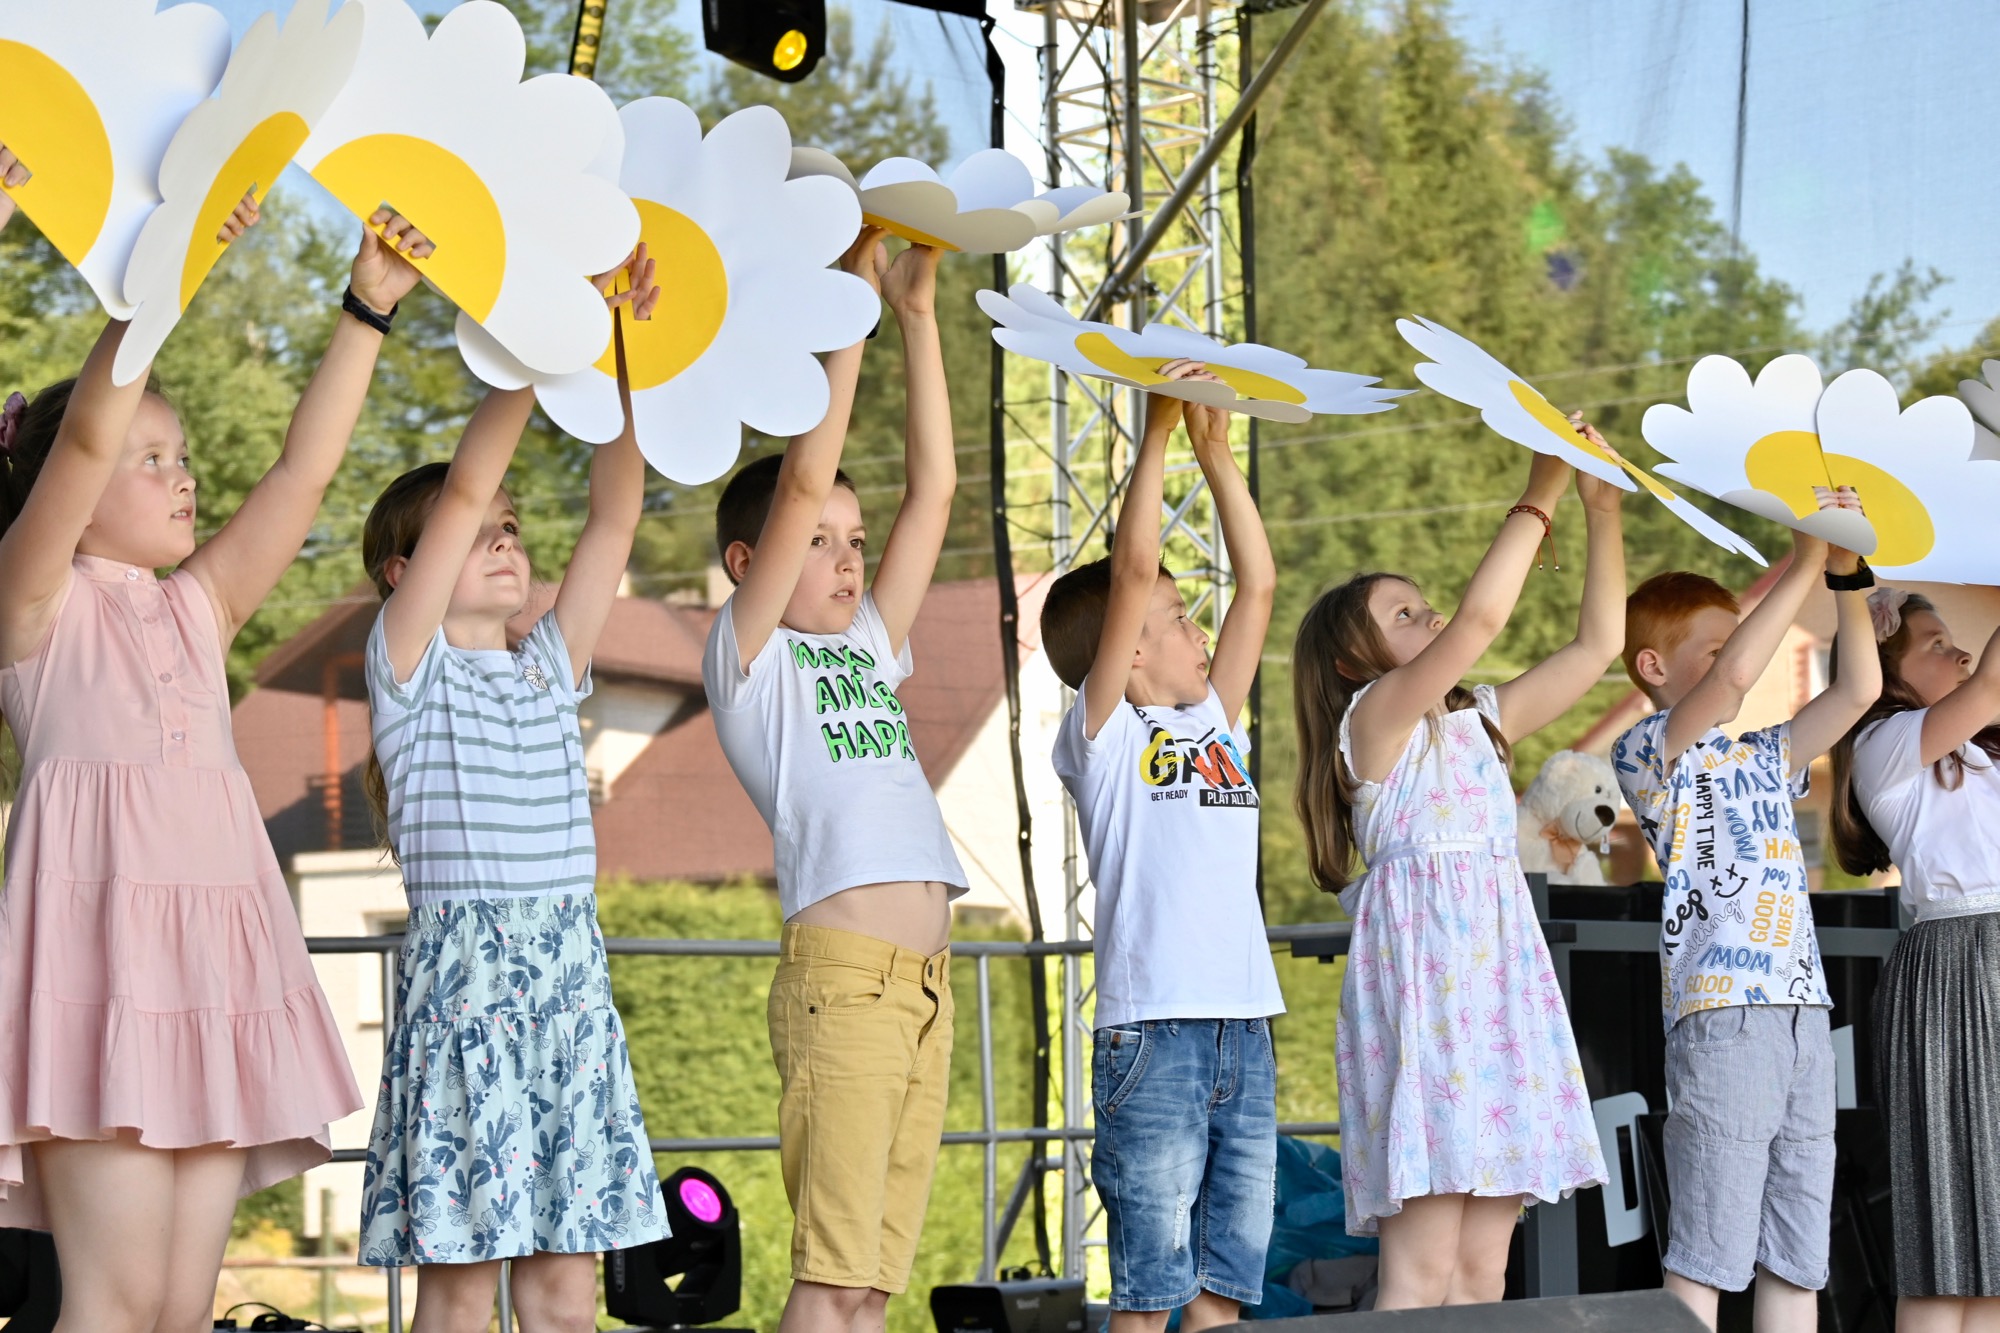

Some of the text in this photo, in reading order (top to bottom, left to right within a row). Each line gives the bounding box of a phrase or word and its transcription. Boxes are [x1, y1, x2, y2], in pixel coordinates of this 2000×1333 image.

[1151, 789, 1189, 802] GET READY
[1207, 791, 1229, 805] PLAY
[1231, 791, 1246, 805] ALL
[1694, 773, 1716, 871] HAPPY TIME
[1724, 806, 1758, 862] WOW!
[1748, 891, 1777, 943] GOOD
[1771, 893, 1795, 948] VIBES
[1698, 943, 1772, 976] WOW!
[1684, 974, 1734, 995] GOOD
